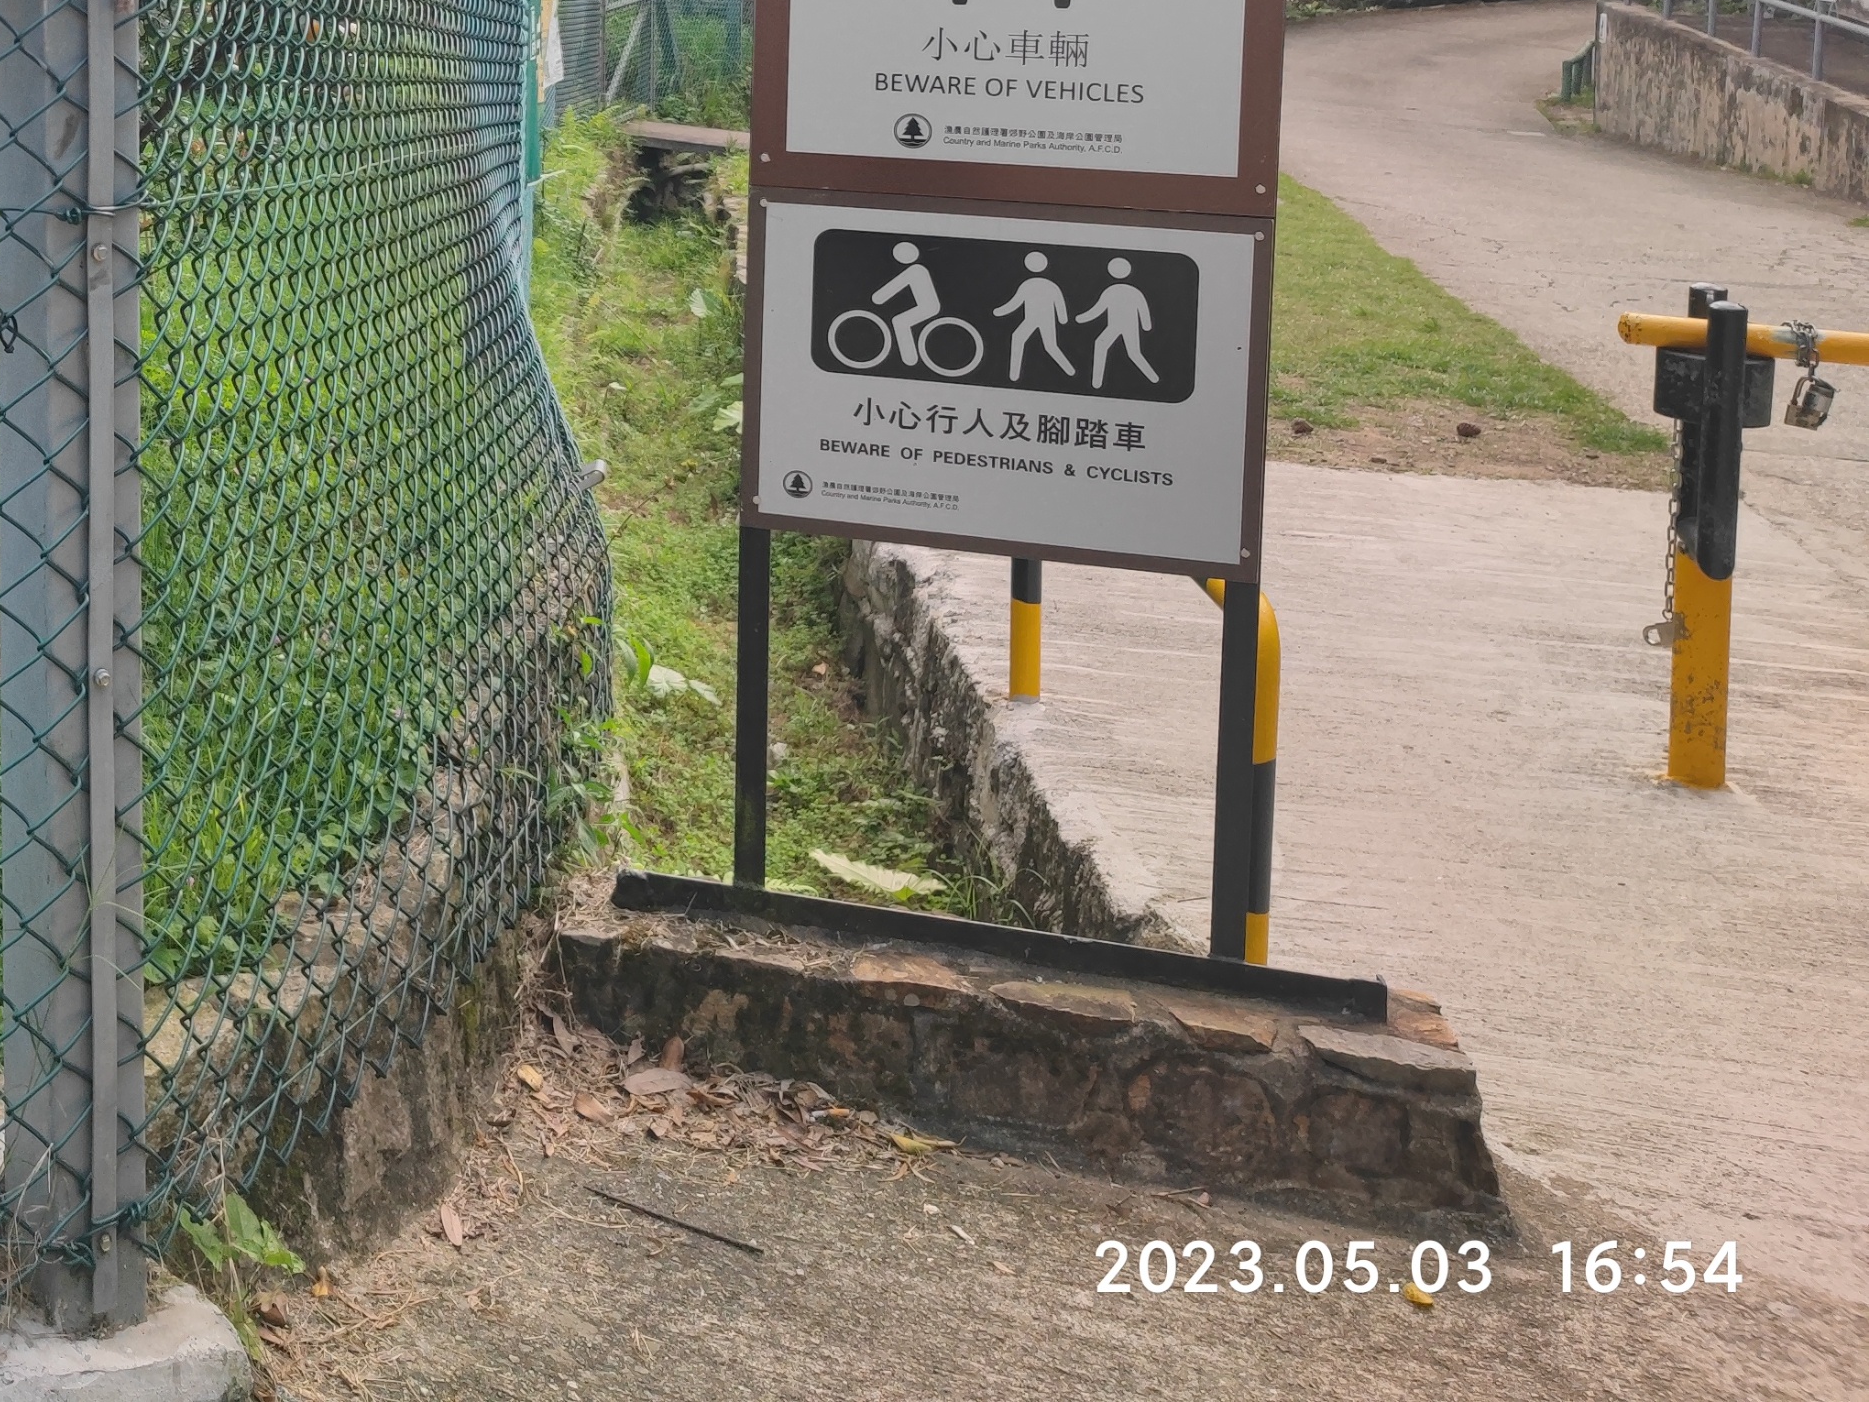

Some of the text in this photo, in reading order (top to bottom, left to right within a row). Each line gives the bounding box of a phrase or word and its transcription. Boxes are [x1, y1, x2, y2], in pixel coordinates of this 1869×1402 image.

[921, 26, 1091, 69] 小心車輛
[874, 72, 1145, 104] BEWARE OF VEHICLES
[942, 135, 974, 148] Country
[976, 138, 991, 147] and
[993, 139, 1021, 149] Marine
[1023, 141, 1047, 150] Parks
[852, 396, 1147, 452] 小心行人及腳踏車
[819, 438, 1174, 487] BEWARE OF PEDESTRIANS & CYCLISTS
